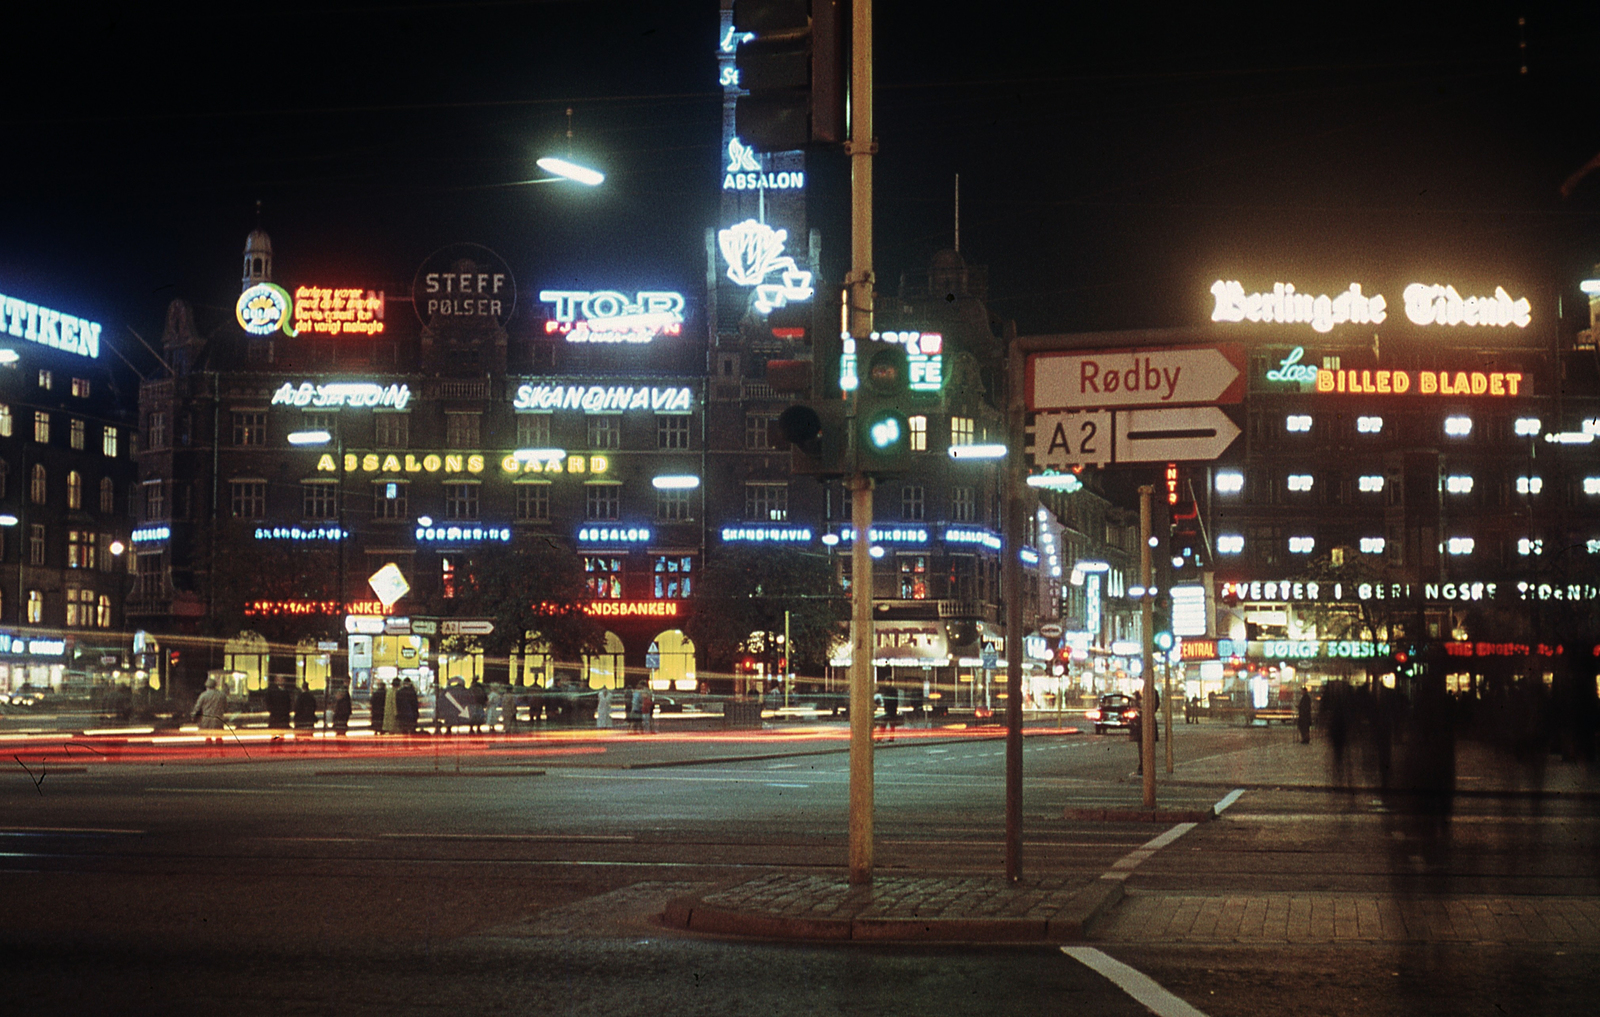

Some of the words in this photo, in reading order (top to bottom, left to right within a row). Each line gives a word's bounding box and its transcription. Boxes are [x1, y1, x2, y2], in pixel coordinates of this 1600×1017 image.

[723, 173, 804, 190] ABSALON
[426, 273, 505, 293] STEFF
[428, 298, 502, 316] PØLSER
[1403, 283, 1531, 327] Tidende
[1266, 346, 1317, 381] Læs
[1079, 357, 1181, 400] Rødby
[1317, 371, 1411, 393] BILLED
[1419, 372, 1522, 395] BLADET
[513, 384, 692, 411] SKANDINAVIA
[317, 453, 485, 474] ABSALONS
[500, 451, 608, 474] GAARD
[578, 528, 650, 541] ABSALON
[722, 529, 811, 542] SKANDINAVIA
[841, 529, 928, 542] FOSIKRING
[1180, 642, 1215, 658] ENTRAL
[1263, 641, 1319, 657] BØRGE
